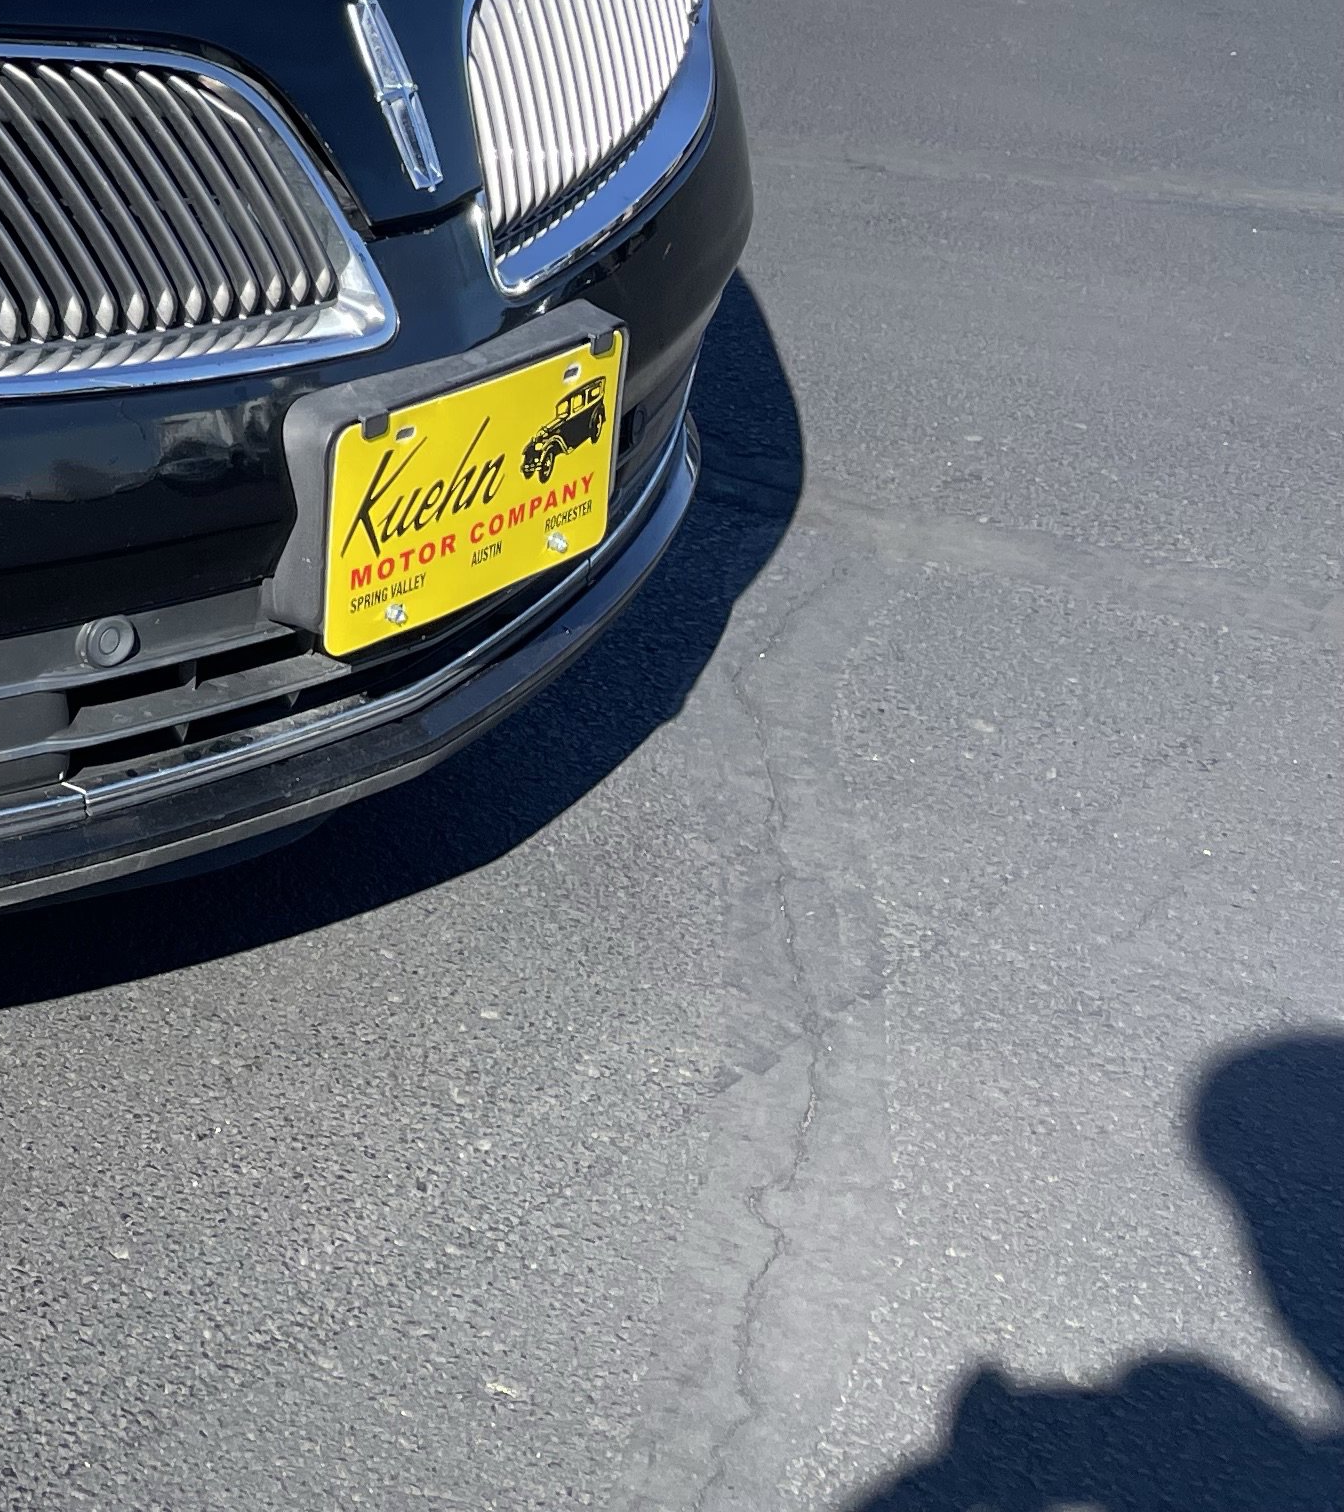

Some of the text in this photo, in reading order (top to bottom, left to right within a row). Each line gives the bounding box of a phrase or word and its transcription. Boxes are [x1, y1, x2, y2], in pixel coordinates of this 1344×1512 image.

[340, 415, 507, 558] Kuehn
[349, 472, 595, 591] MOTOR COMPANY
[544, 499, 594, 534] ROCHESTER
[471, 541, 503, 568] AUSTIN
[349, 572, 428, 615] SPRING VALLEY
